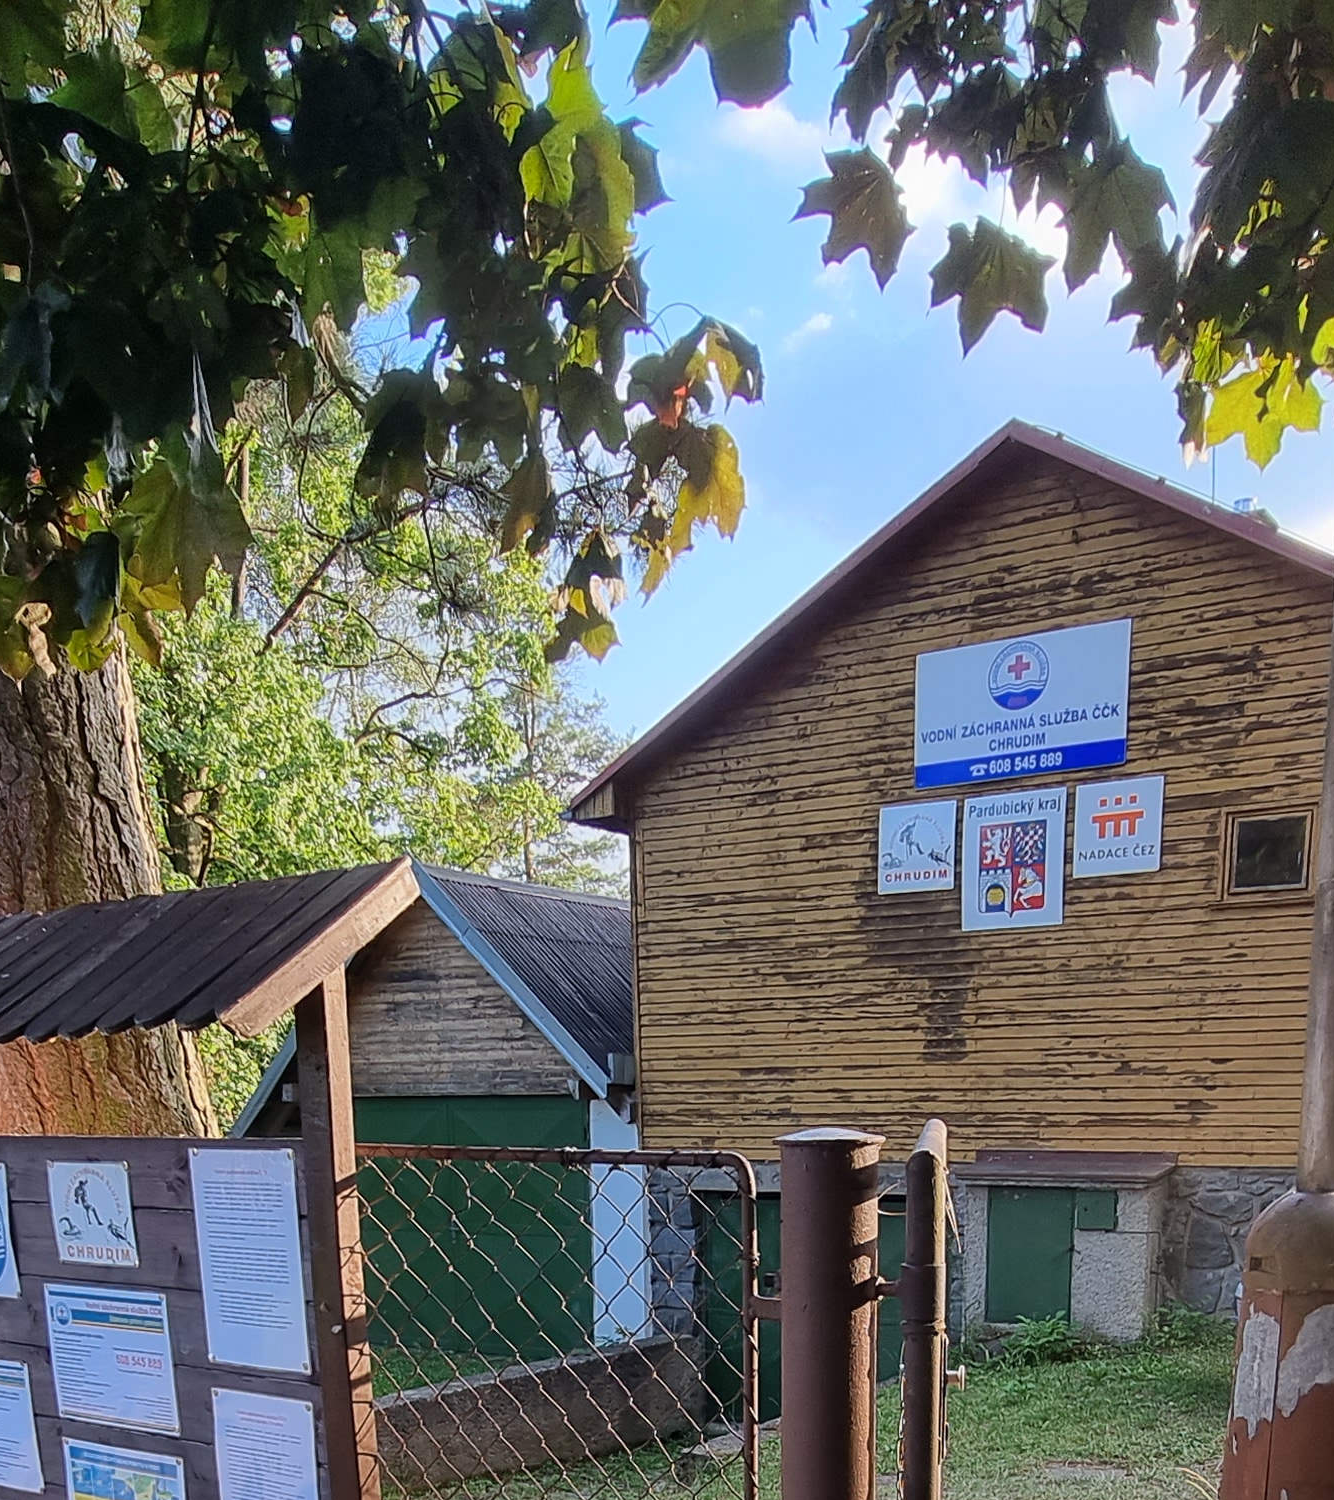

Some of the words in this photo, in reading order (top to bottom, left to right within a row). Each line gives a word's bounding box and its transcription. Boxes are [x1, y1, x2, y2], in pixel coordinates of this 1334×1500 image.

[920, 724, 957, 744] VODNÍ
[961, 713, 1036, 739] ZÁCHRANNÁ
[1039, 707, 1088, 728] SLUŽBA
[1092, 702, 1120, 720] ČČK
[989, 732, 1046, 752] CHRUDIM
[989, 758, 1011, 774] 608
[1014, 754, 1036, 771] 545
[1039, 751, 1063, 767] 889
[969, 797, 1034, 819] Pardubický
[1038, 795, 1061, 812] kraj
[1078, 847, 1128, 862] NADACE
[1132, 843, 1155, 857] ČEZ
[884, 869, 948, 883] CHRUDIM
[67, 1244, 131, 1261] CHRUDIM
